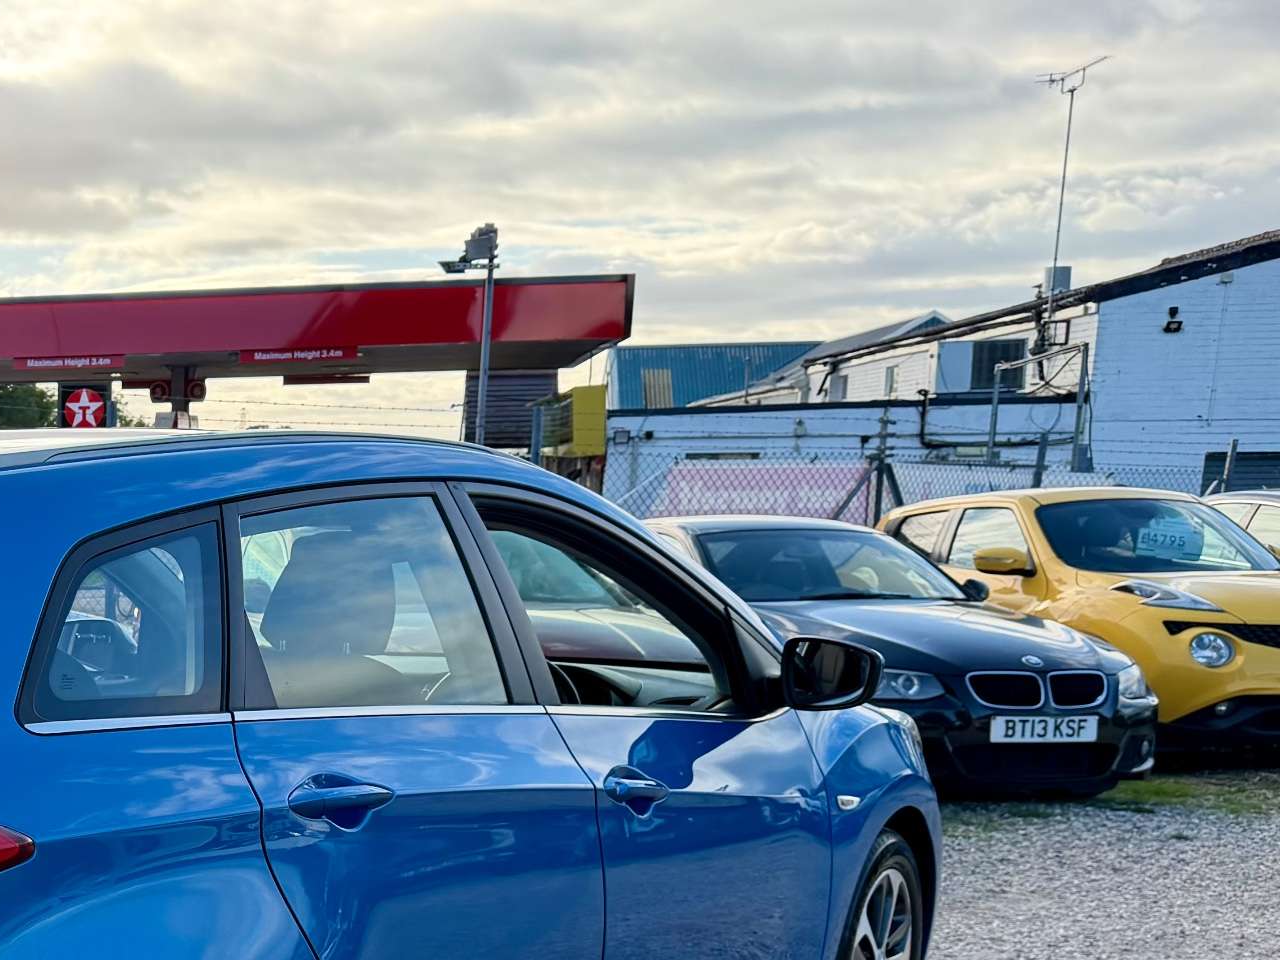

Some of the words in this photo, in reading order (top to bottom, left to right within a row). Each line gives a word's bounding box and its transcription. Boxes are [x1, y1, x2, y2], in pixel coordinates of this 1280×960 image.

[254, 352, 292, 360] Maximum
[294, 350, 320, 360] Height
[321, 350, 343, 358] 3.4m
[27, 359, 63, 367] Maximum
[64, 358, 90, 367] Height
[91, 357, 111, 366] 3.4m
[1003, 719, 1048, 738] BT13
[1053, 719, 1087, 738] KSF
